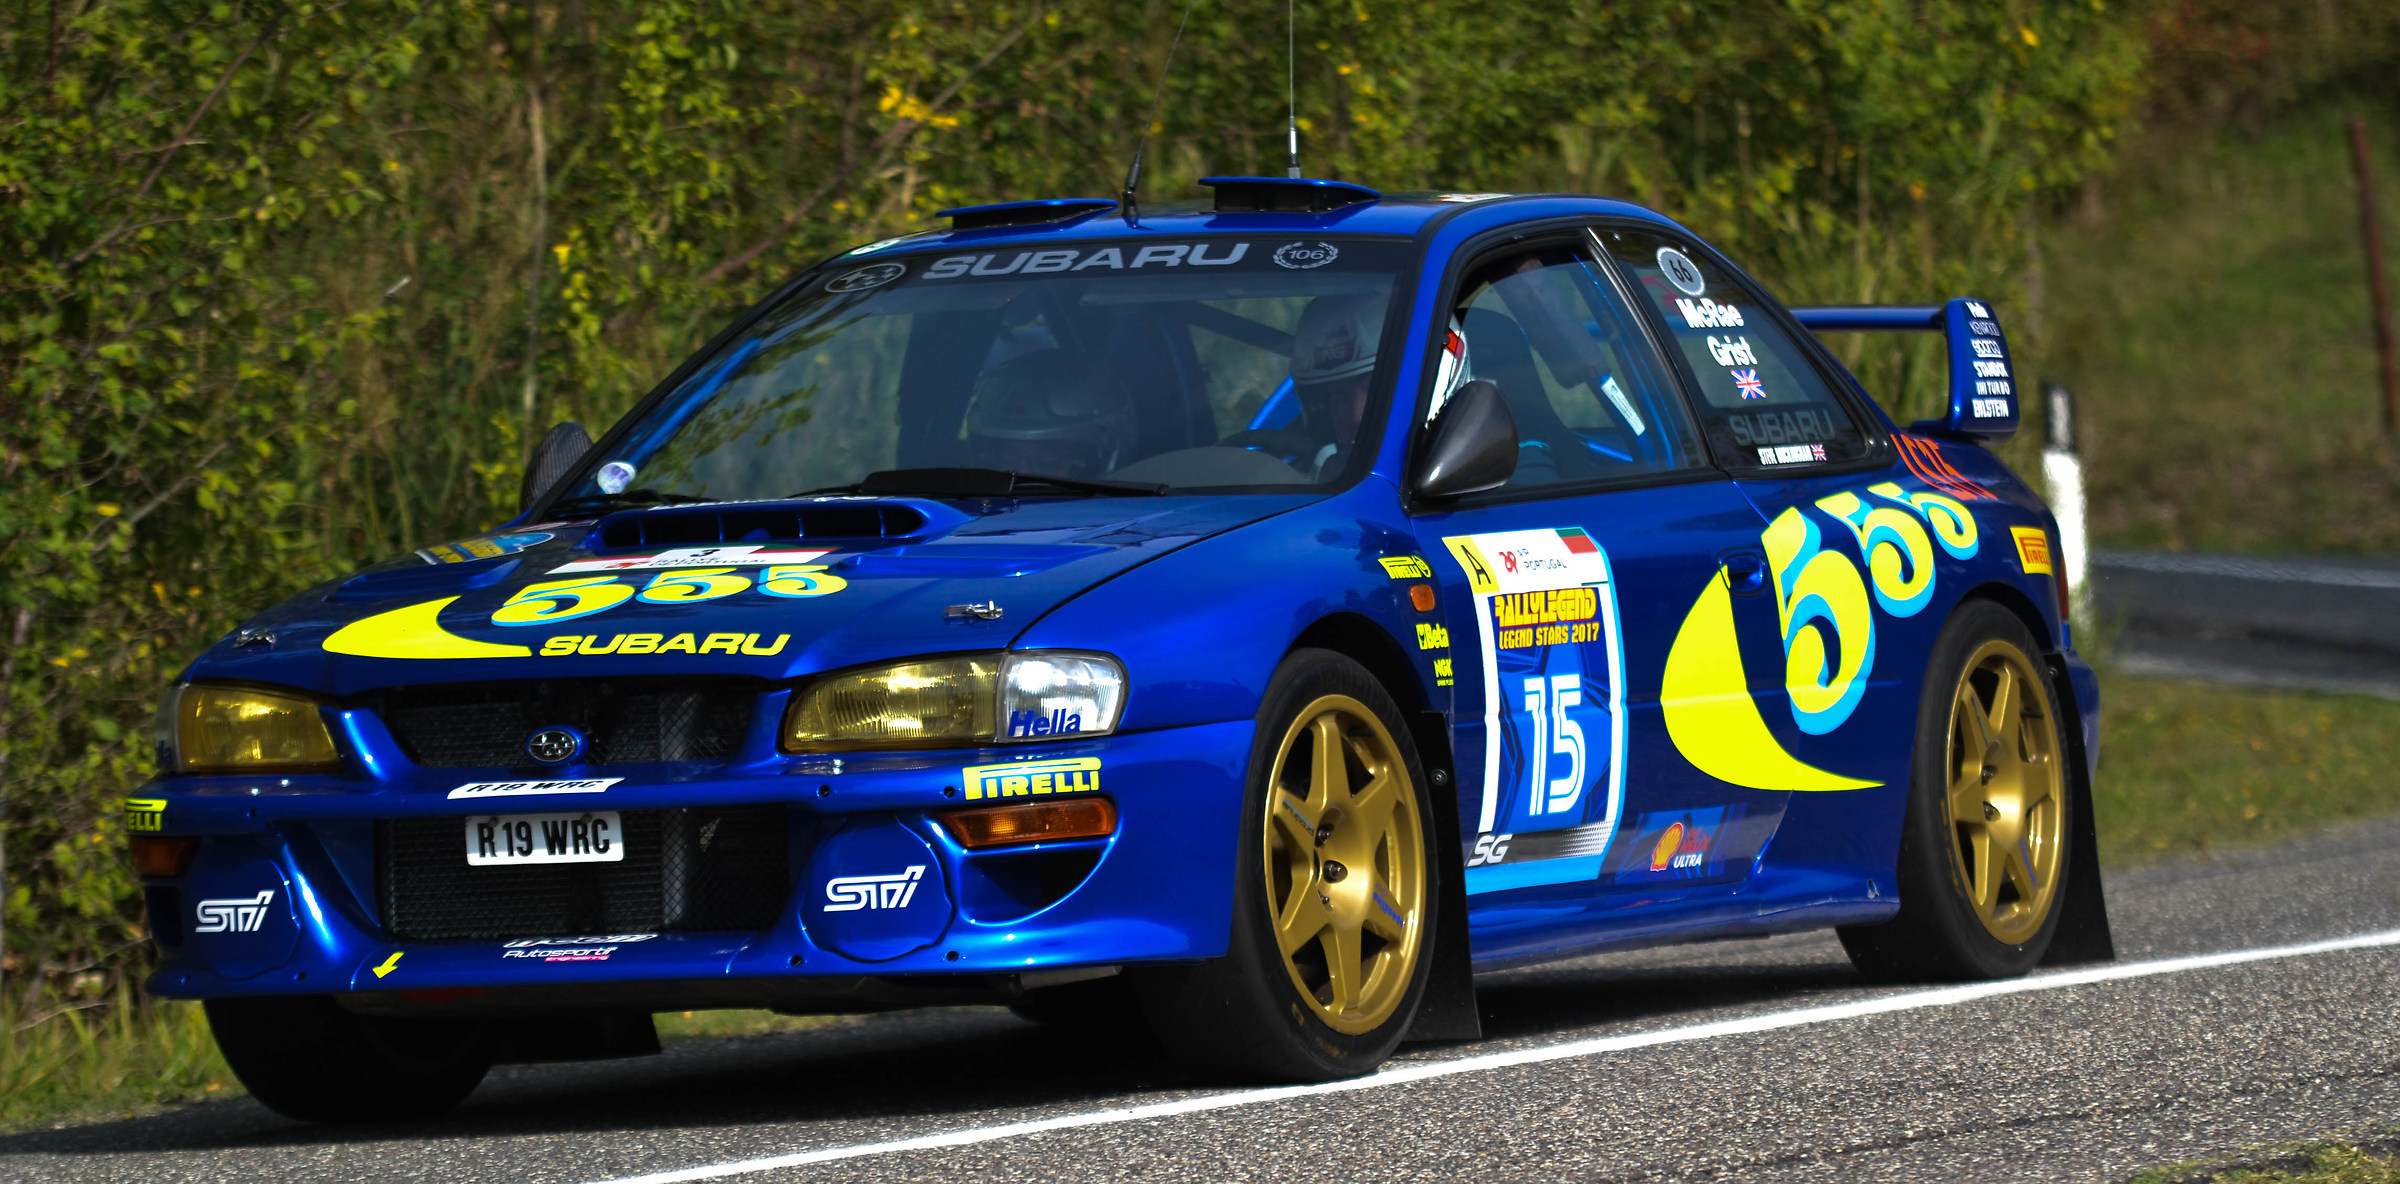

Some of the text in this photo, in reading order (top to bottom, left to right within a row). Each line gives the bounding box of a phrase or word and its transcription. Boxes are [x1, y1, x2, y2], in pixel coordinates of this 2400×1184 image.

[922, 243, 1249, 280] SUBARU
[1289, 249, 1322, 262] 106
[1668, 258, 1693, 283] 66
[1675, 298, 1743, 328] McRae
[1707, 335, 1756, 366] Grist
[1971, 399, 2010, 418] BILSTEIN
[1731, 411, 1835, 446] SUBARU
[1378, 556, 1422, 579] PIRELLI
[1461, 544, 1491, 585] A
[490, 565, 846, 627] 555
[1494, 588, 1597, 627] RALLYLEGEND
[1760, 482, 1980, 735] 555
[540, 632, 792, 658] SUBARU
[1424, 622, 1450, 650] Beta
[1499, 622, 1600, 650] LEGEND STARS 2017
[1434, 659, 1453, 678] NGK
[1009, 709, 1081, 737] Hella
[1522, 673, 1586, 816] 15
[465, 780, 604, 793] R 19 WRC
[962, 757, 1101, 800] PIRELLI
[477, 818, 611, 858] R 19 WRC
[1467, 834, 1513, 866] SG
[1673, 853, 1704, 869] ULTRA
